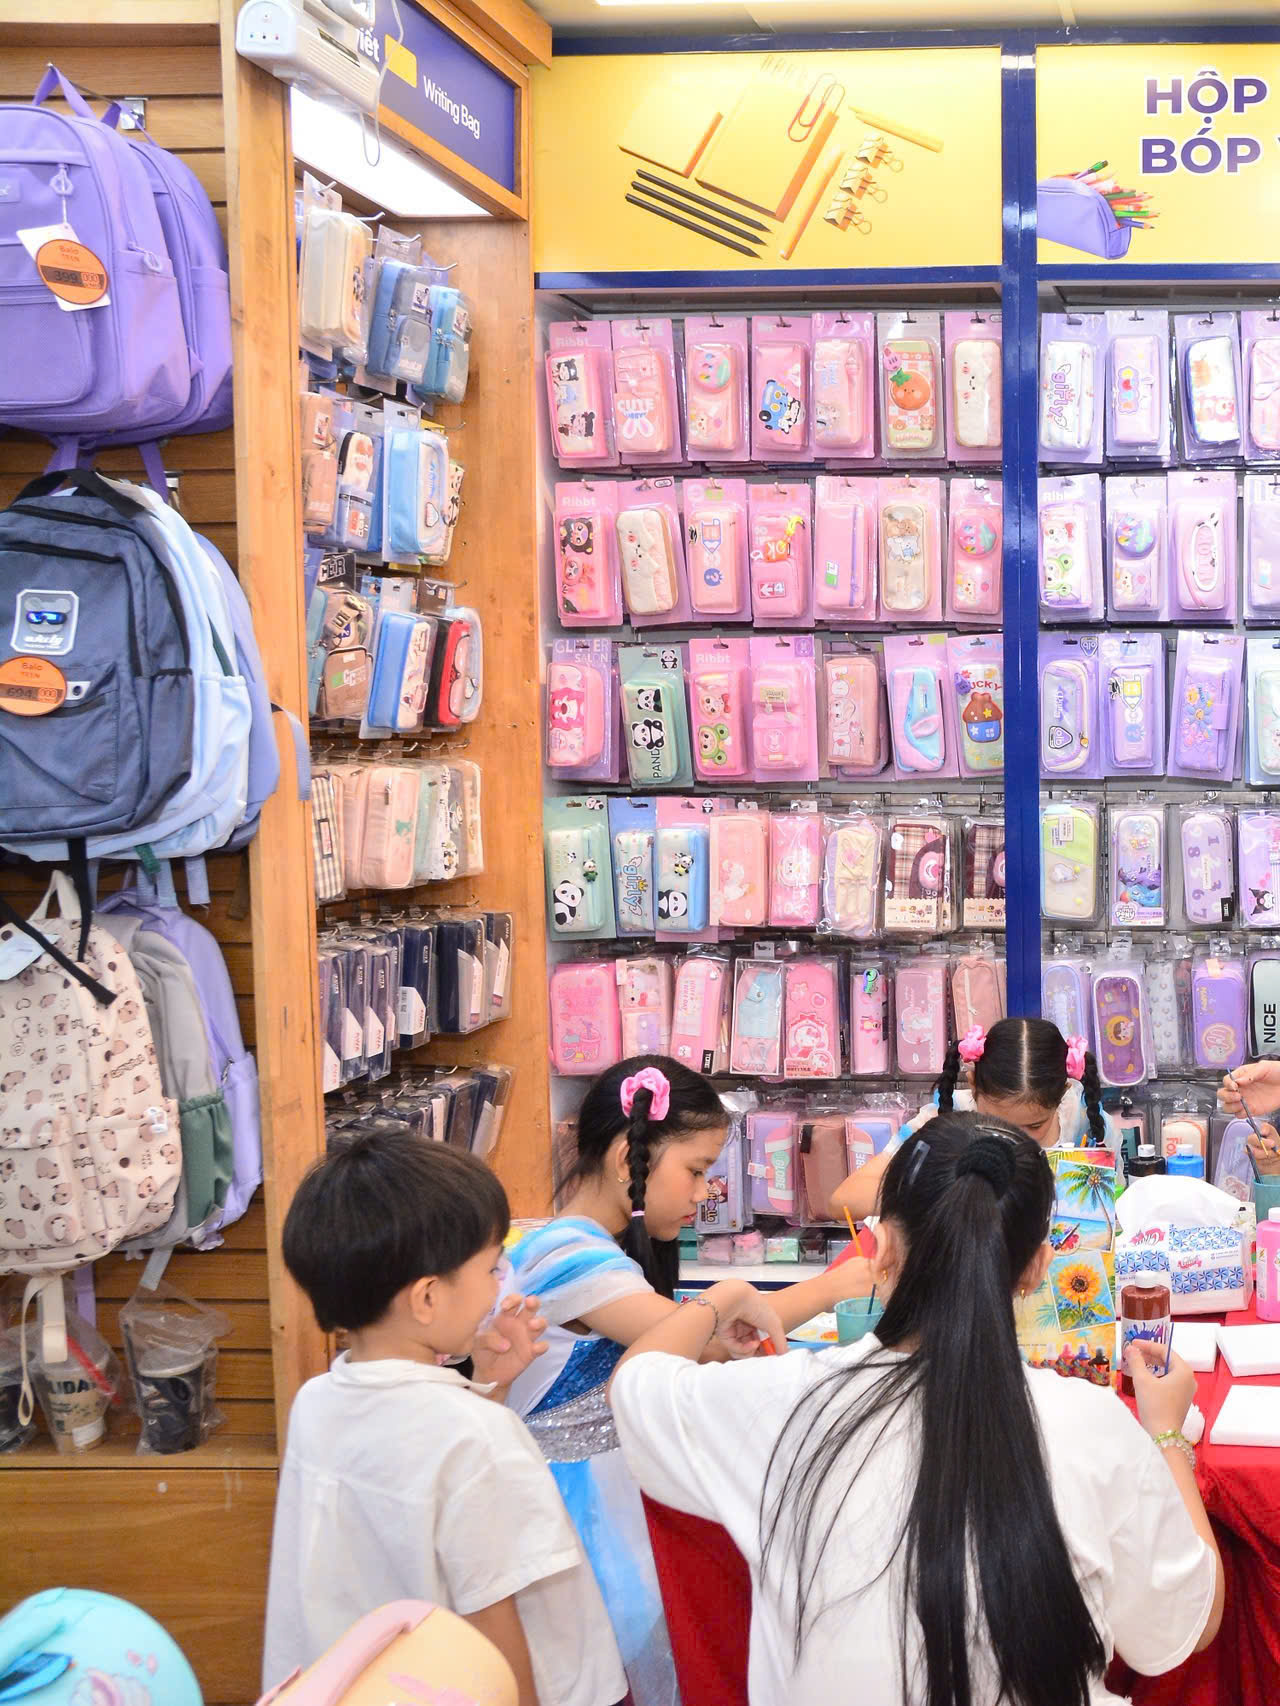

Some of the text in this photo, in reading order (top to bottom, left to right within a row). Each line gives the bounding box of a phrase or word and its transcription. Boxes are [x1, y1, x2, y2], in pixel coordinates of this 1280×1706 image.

[423, 75, 481, 140] Writing Bag
[1145, 66, 1268, 124] HỘP
[1141, 127, 1262, 175] BÓP
[617, 398, 656, 412] CUTE
[1050, 372, 1066, 419] girly
[695, 653, 731, 665] Ribbt
[966, 679, 1002, 692] UCKY
[652, 748, 662, 779] PAND
[622, 863, 641, 907] girly
[1262, 1003, 1277, 1044] NICE
[773, 1157, 787, 1191] GLOBE
